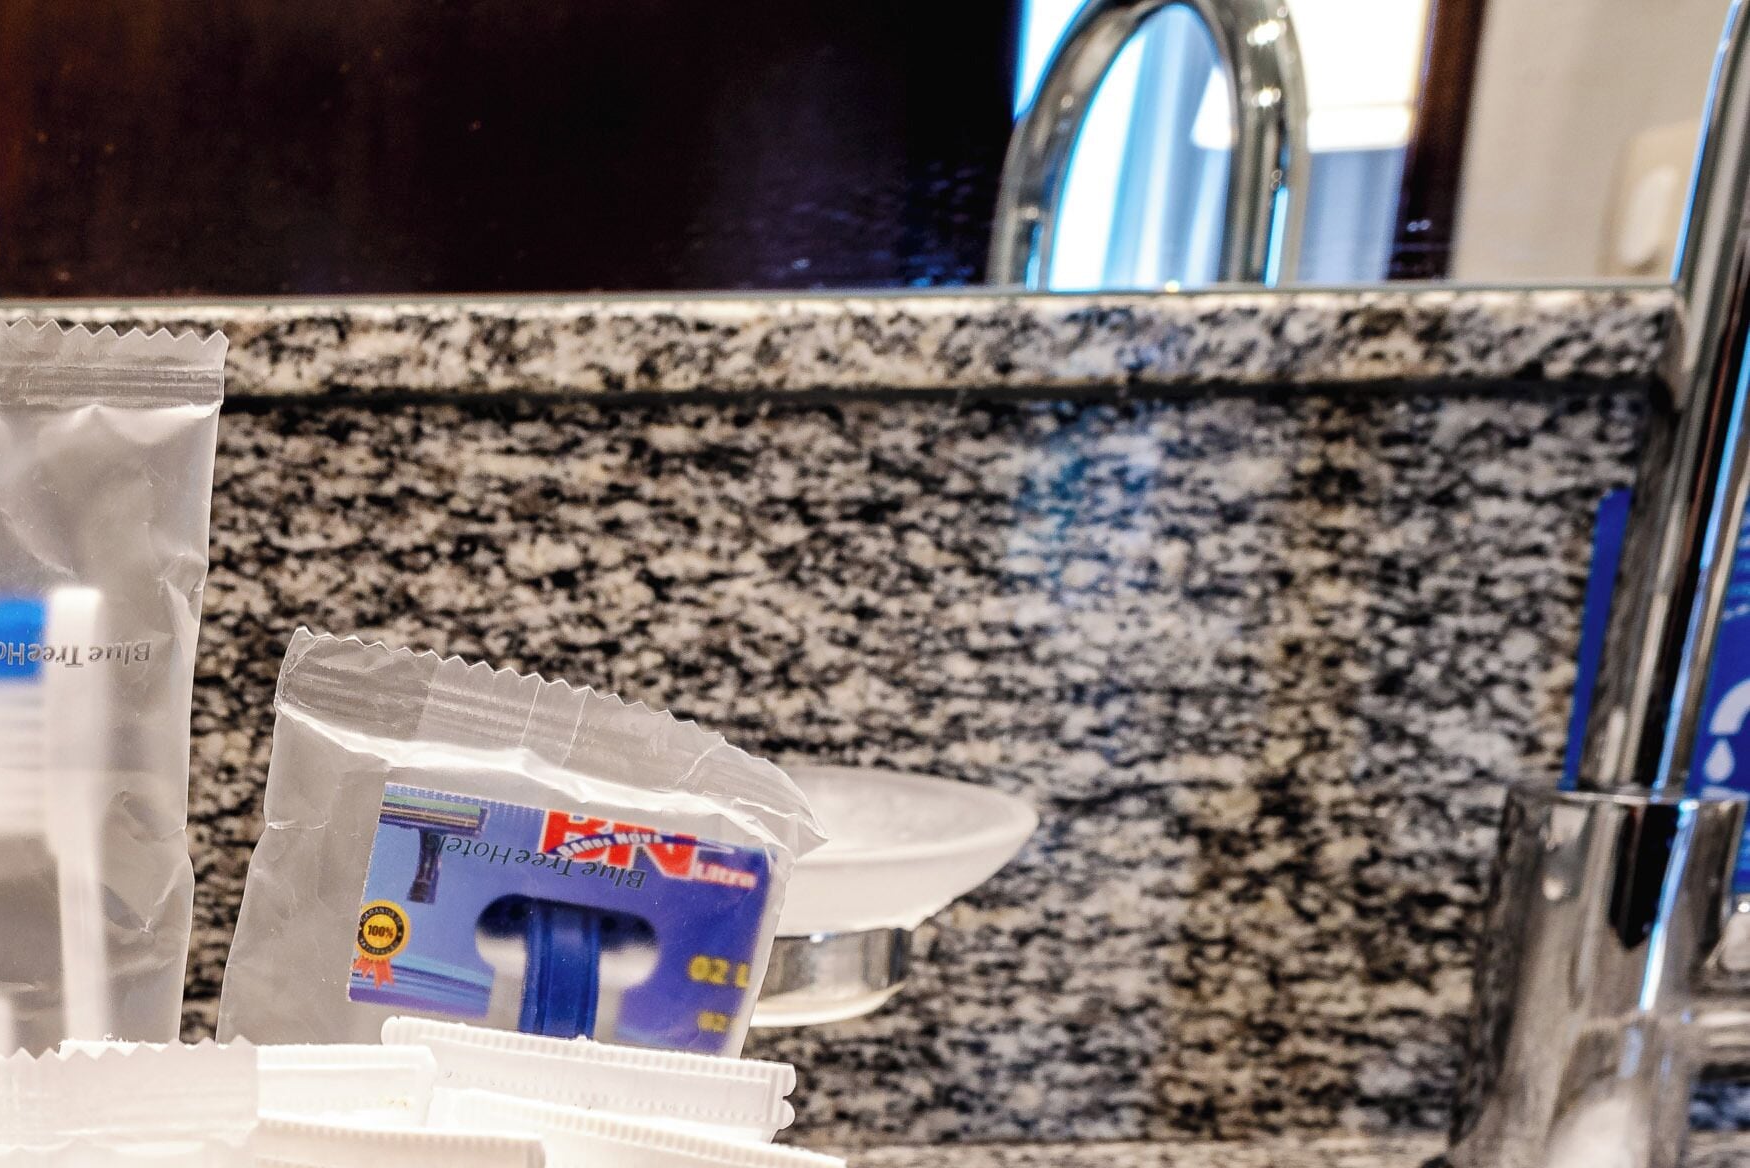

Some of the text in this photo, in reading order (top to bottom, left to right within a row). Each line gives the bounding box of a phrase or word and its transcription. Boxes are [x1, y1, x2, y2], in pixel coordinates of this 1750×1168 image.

[88, 639, 152, 666] Blue
[540, 808, 699, 880] BN
[581, 860, 648, 891] Blue
[367, 924, 395, 940] 100%
